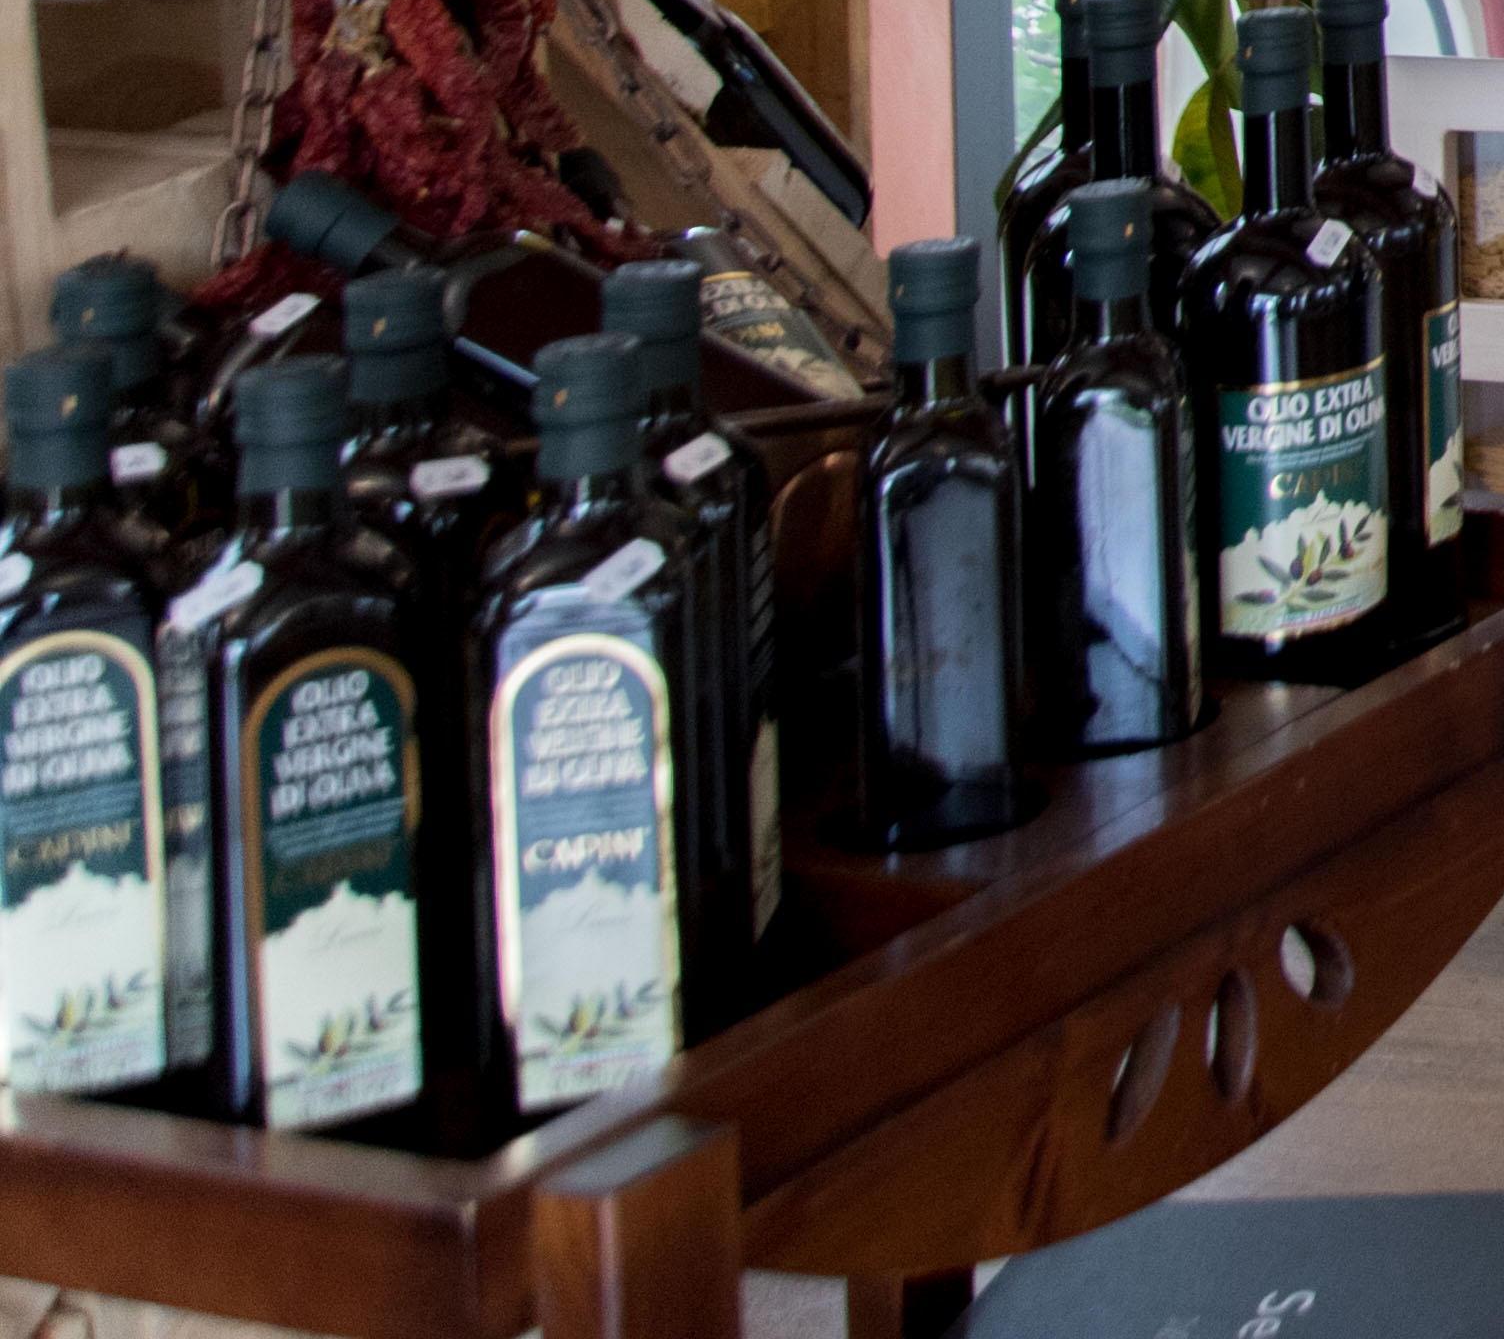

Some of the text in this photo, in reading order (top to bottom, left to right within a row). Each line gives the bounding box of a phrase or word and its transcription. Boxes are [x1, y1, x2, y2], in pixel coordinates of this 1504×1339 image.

[1247, 374, 1374, 424] OLIO EXTRA
[1221, 418, 1316, 453] VERGINE
[1319, 412, 1342, 444] DI
[291, 670, 370, 715] OLIO
[282, 699, 380, 751] EXTRA
[272, 726, 394, 783] VERGINE
[270, 779, 305, 818] DI
